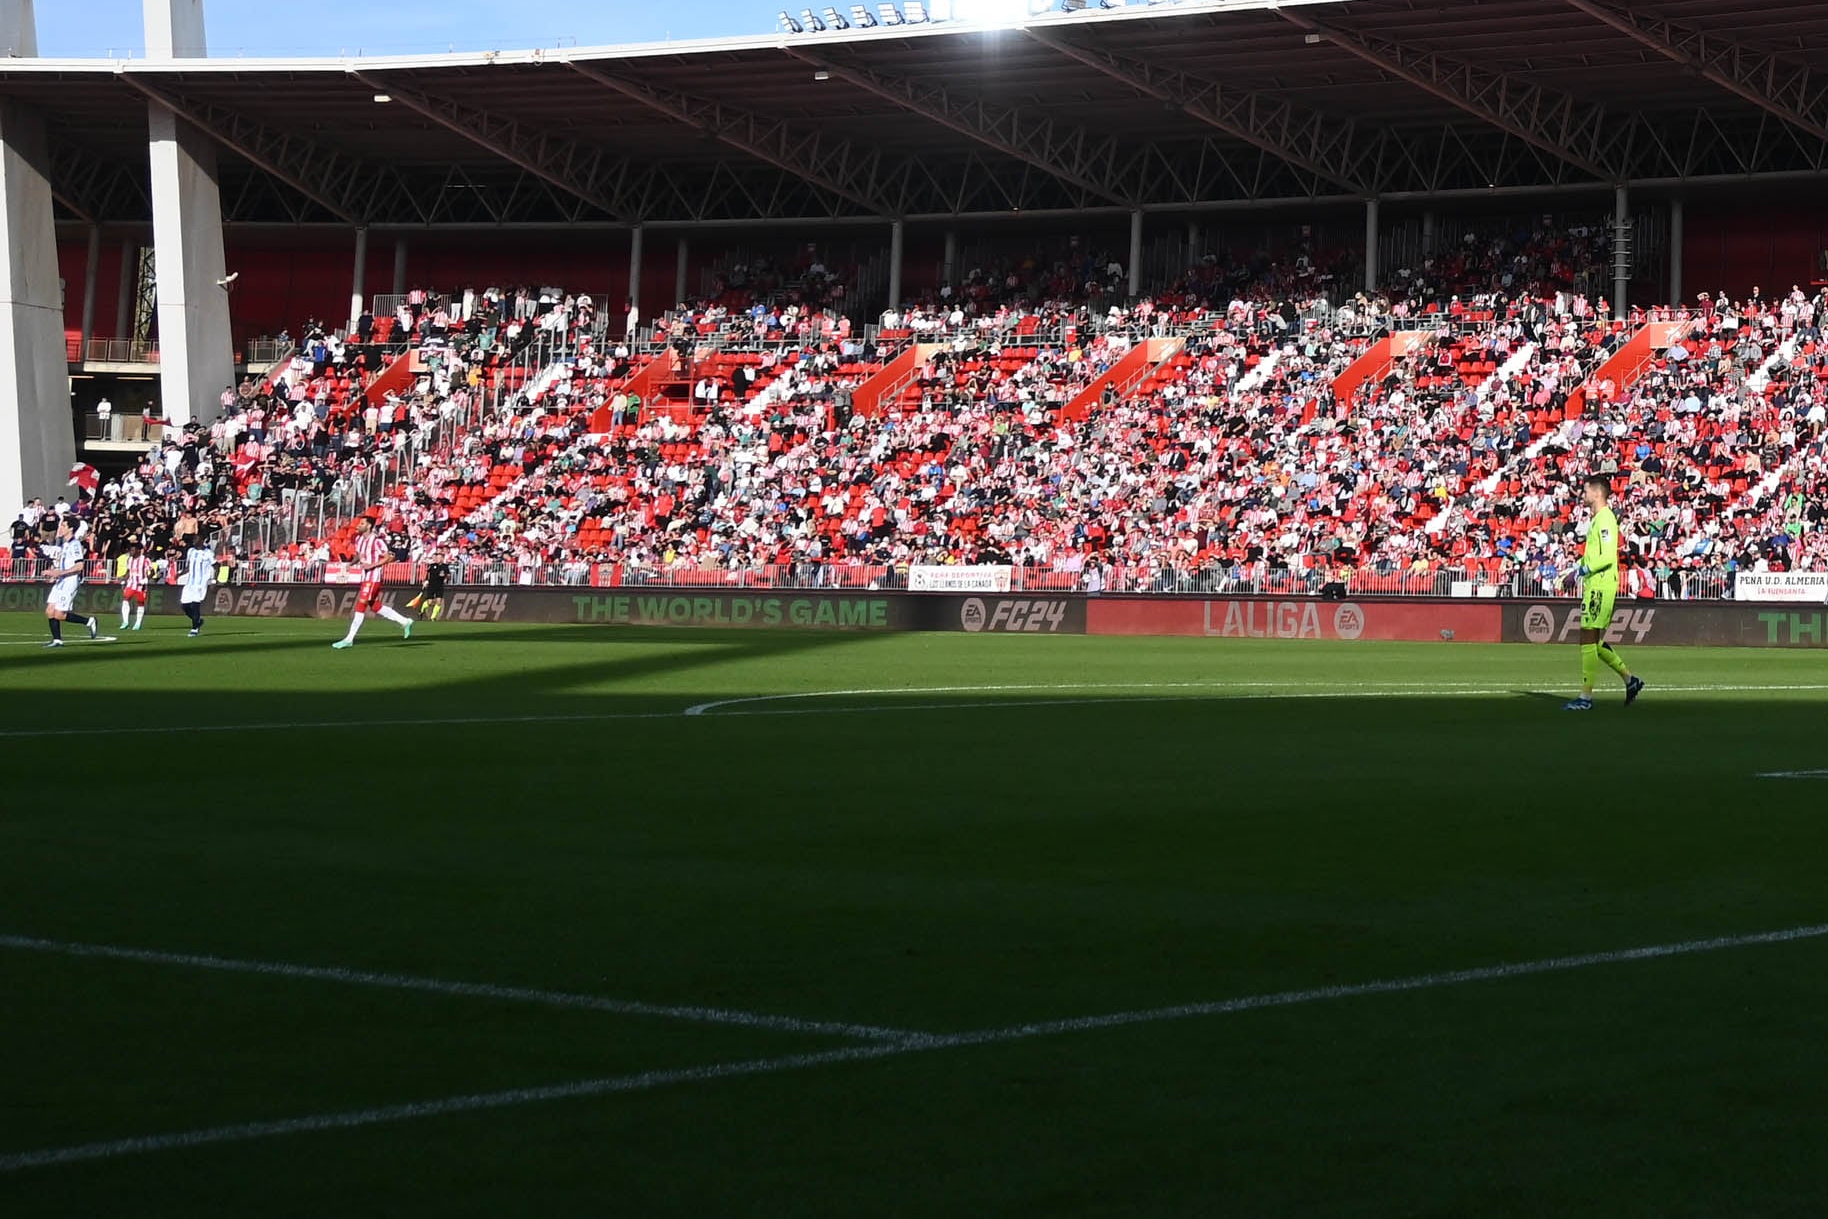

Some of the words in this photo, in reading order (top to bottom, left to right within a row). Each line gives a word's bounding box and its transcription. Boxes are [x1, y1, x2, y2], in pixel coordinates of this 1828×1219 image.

[1784, 576, 1825, 586] ALMERIA
[92, 589, 163, 611] GAE
[234, 589, 289, 615] FC24
[447, 592, 509, 621] FC24
[572, 595, 629, 623] THE
[638, 596, 783, 625] WORLD'S
[790, 599, 888, 626] GAME
[965, 604, 981, 617] EA
[987, 600, 1067, 631] FC24
[1203, 600, 1322, 639] LALIGA
[1340, 610, 1358, 624] EA
[1529, 612, 1549, 627] EA
[1558, 608, 1656, 643] F24
[1528, 626, 1550, 634] SPORTS
